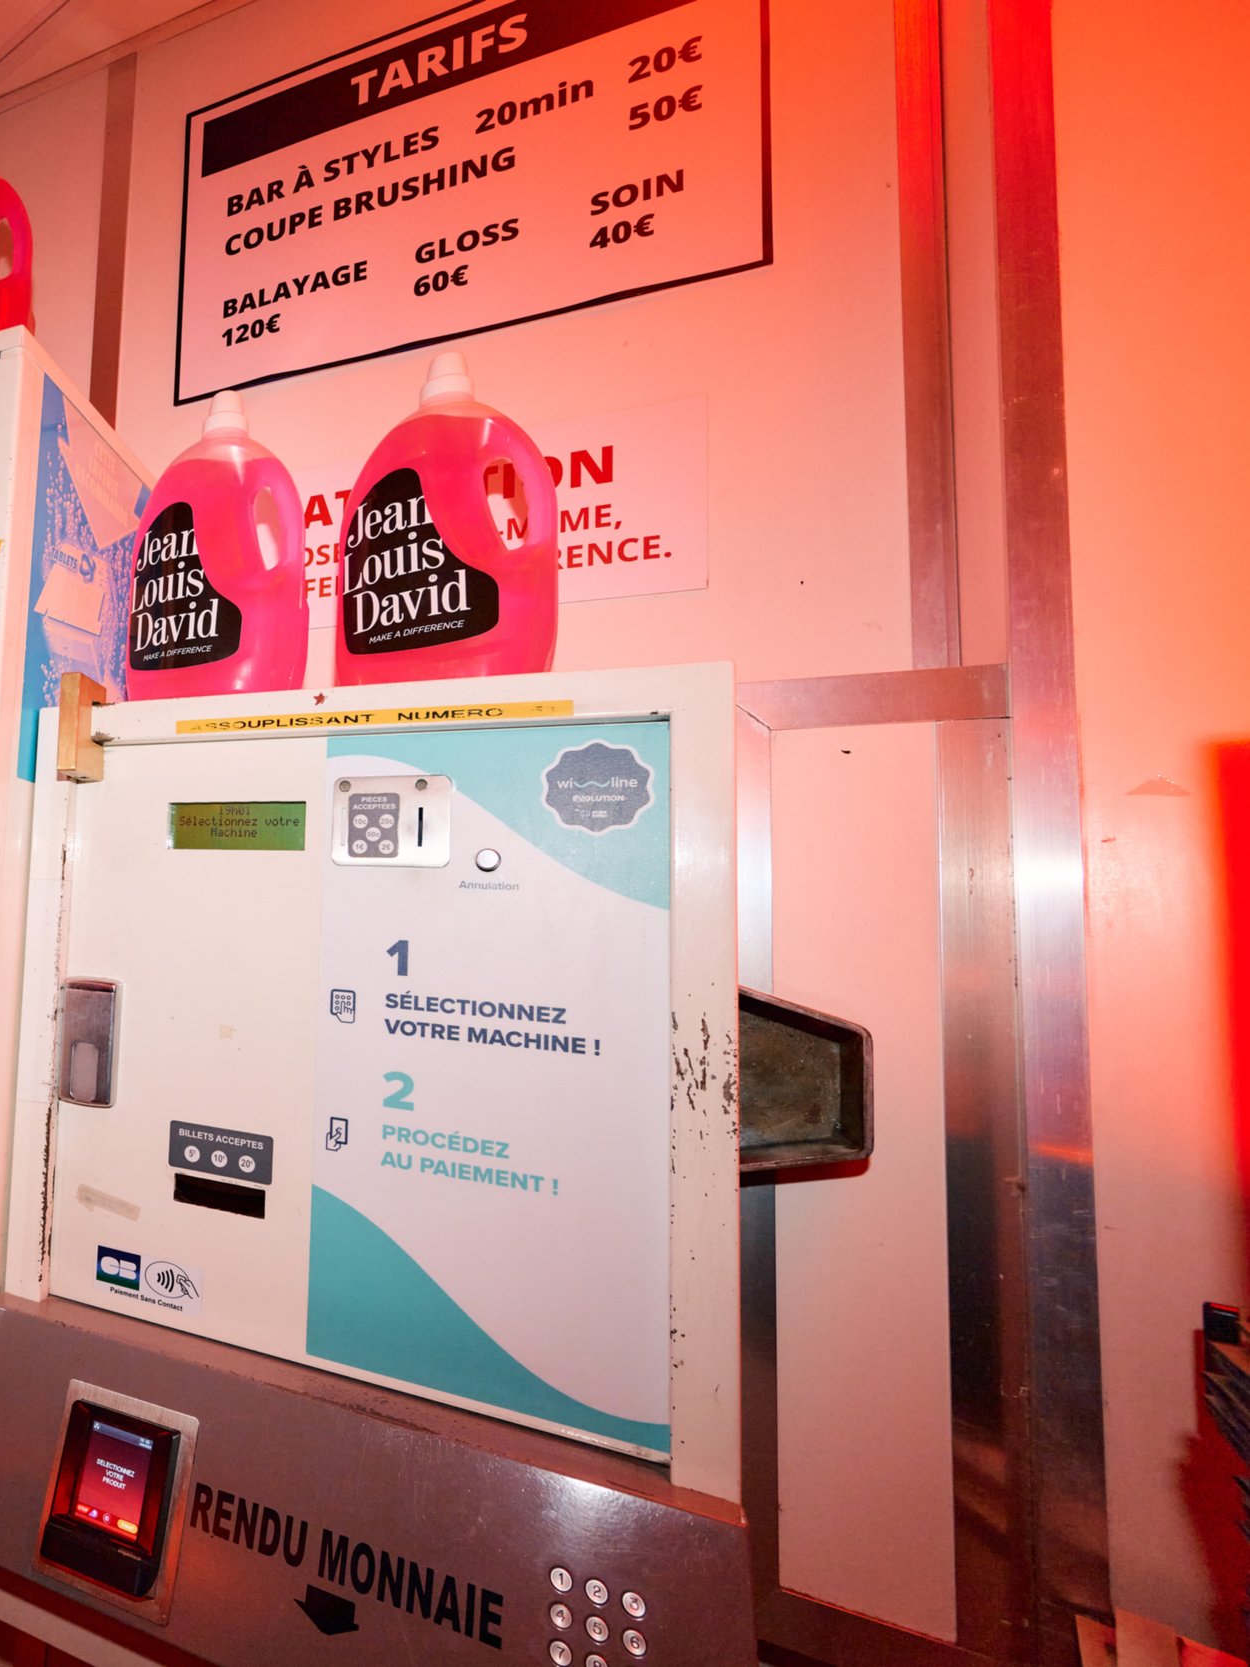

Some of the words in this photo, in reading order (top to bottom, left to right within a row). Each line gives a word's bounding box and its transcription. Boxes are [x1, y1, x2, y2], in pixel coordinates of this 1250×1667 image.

[350, 14, 529, 106] TARIFS
[475, 78, 594, 135] 20min
[628, 36, 703, 83] 20€
[224, 205, 323, 256] COUPE
[332, 147, 516, 220] BRUSHING
[628, 85, 703, 131] 50€
[226, 180, 285, 217] BAR
[292, 165, 315, 196] À
[324, 126, 440, 182] STYLES
[222, 261, 368, 319] BALAYAGE
[415, 218, 519, 264] GLOSS
[590, 169, 685, 216] SOIN
[222, 313, 281, 347] 120€
[413, 264, 469, 297] 60€
[589, 213, 655, 249] 40€
[347, 495, 434, 549] Jean
[136, 528, 199, 571] Jean
[343, 531, 445, 595] Louis
[131, 561, 204, 614] Louis
[353, 569, 471, 635] David
[134, 598, 219, 652] David
[368, 632, 393, 645] MAKE
[394, 630, 401, 638] A
[403, 619, 465, 637] DIFFERENCE
[143, 651, 160, 661] MAKE
[166, 645, 213, 657] DIFFERENCE
[397, 707, 504, 721] NUMERO
[179, 815, 258, 827] Sélectionnez
[265, 817, 300, 827] votre
[210, 827, 258, 838] Machine
[355, 843, 365, 851] 1€
[381, 843, 391, 851] 2€
[458, 880, 520, 892] Annulation
[386, 939, 409, 977] 1
[385, 990, 567, 1025] SÉLECTIONNEZ
[384, 1018, 460, 1041] VOTRE
[467, 1027, 587, 1055] MACHINE
[382, 1070, 415, 1112] 2
[178, 1128, 214, 1142] BILLETS
[215, 1135, 264, 1150] ACCEPTES
[381, 1124, 510, 1159] PROCÉDEZ
[380, 1150, 412, 1170] AU
[419, 1157, 544, 1193] PAIEMENT
[100, 1256, 137, 1281] CB
[110, 1286, 139, 1301] Paiement
[140, 1294, 156, 1305] Sans
[157, 1299, 183, 1312] Contact
[96, 1458, 135, 1478] SELECTIONNEZ
[102, 1476, 126, 1490] PRODUIT
[105, 1469, 124, 1482] VOTRE
[189, 1482, 308, 1568] RENDU
[317, 1528, 504, 1650] MONNAIE
[593, 1585, 602, 1599] 2
[556, 1609, 566, 1622] 4
[592, 1622, 602, 1635] 5
[630, 1636, 640, 1649] 6
[556, 1646, 566, 1659] 7
